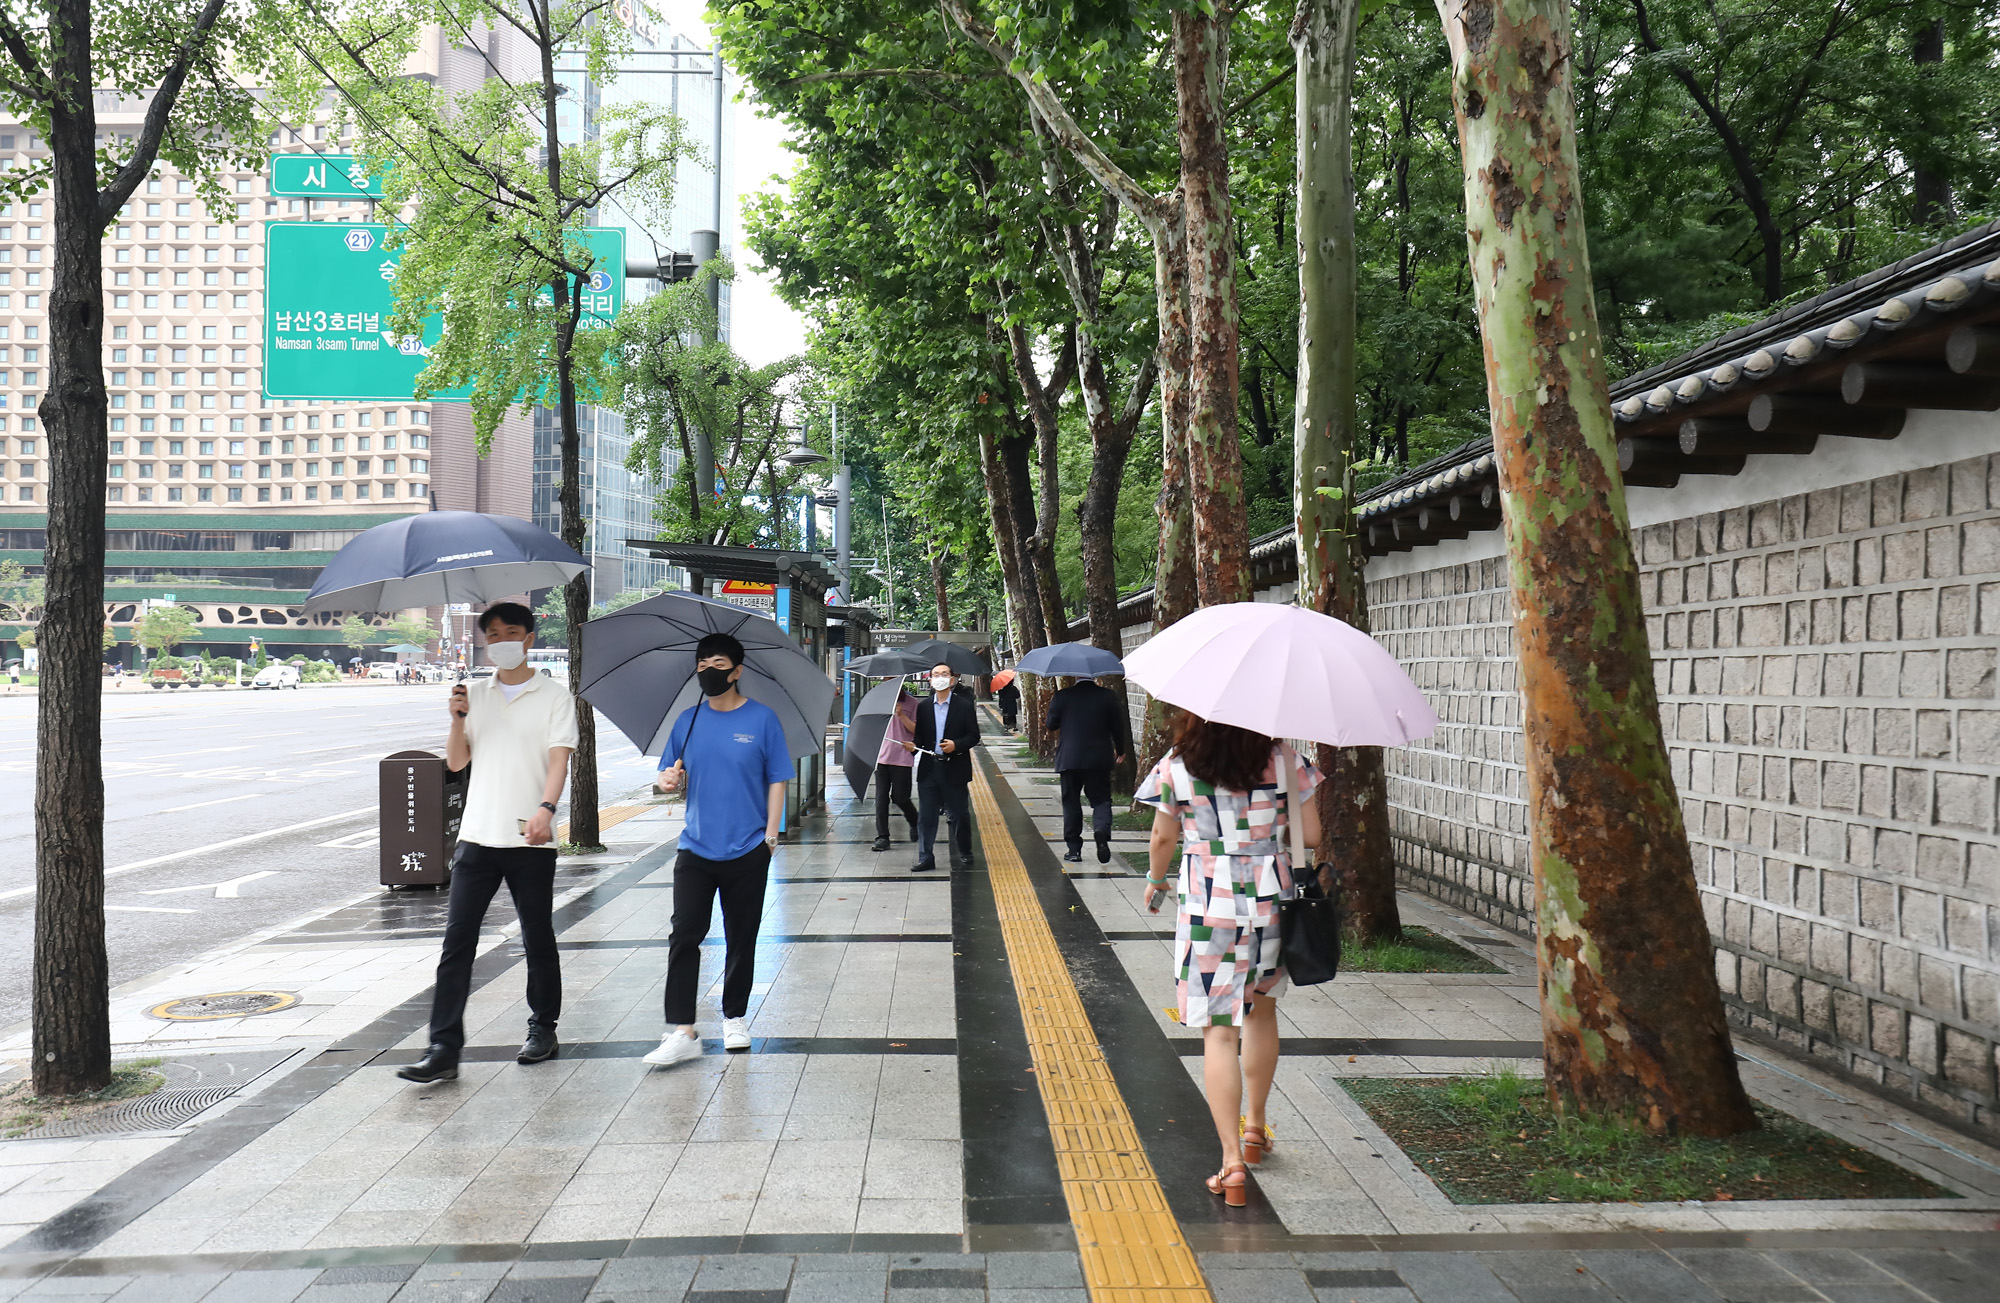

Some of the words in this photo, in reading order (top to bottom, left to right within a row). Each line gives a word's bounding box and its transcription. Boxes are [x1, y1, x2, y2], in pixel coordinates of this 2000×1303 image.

[352, 233, 367, 247] 21
[590, 273, 603, 290] 6
[275, 310, 380, 333] 남산3호터널
[275, 336, 312, 350] Namsan
[316, 336, 348, 351] 3(sam)
[350, 337, 380, 351] Tunnel
[403, 338, 418, 351] 31
